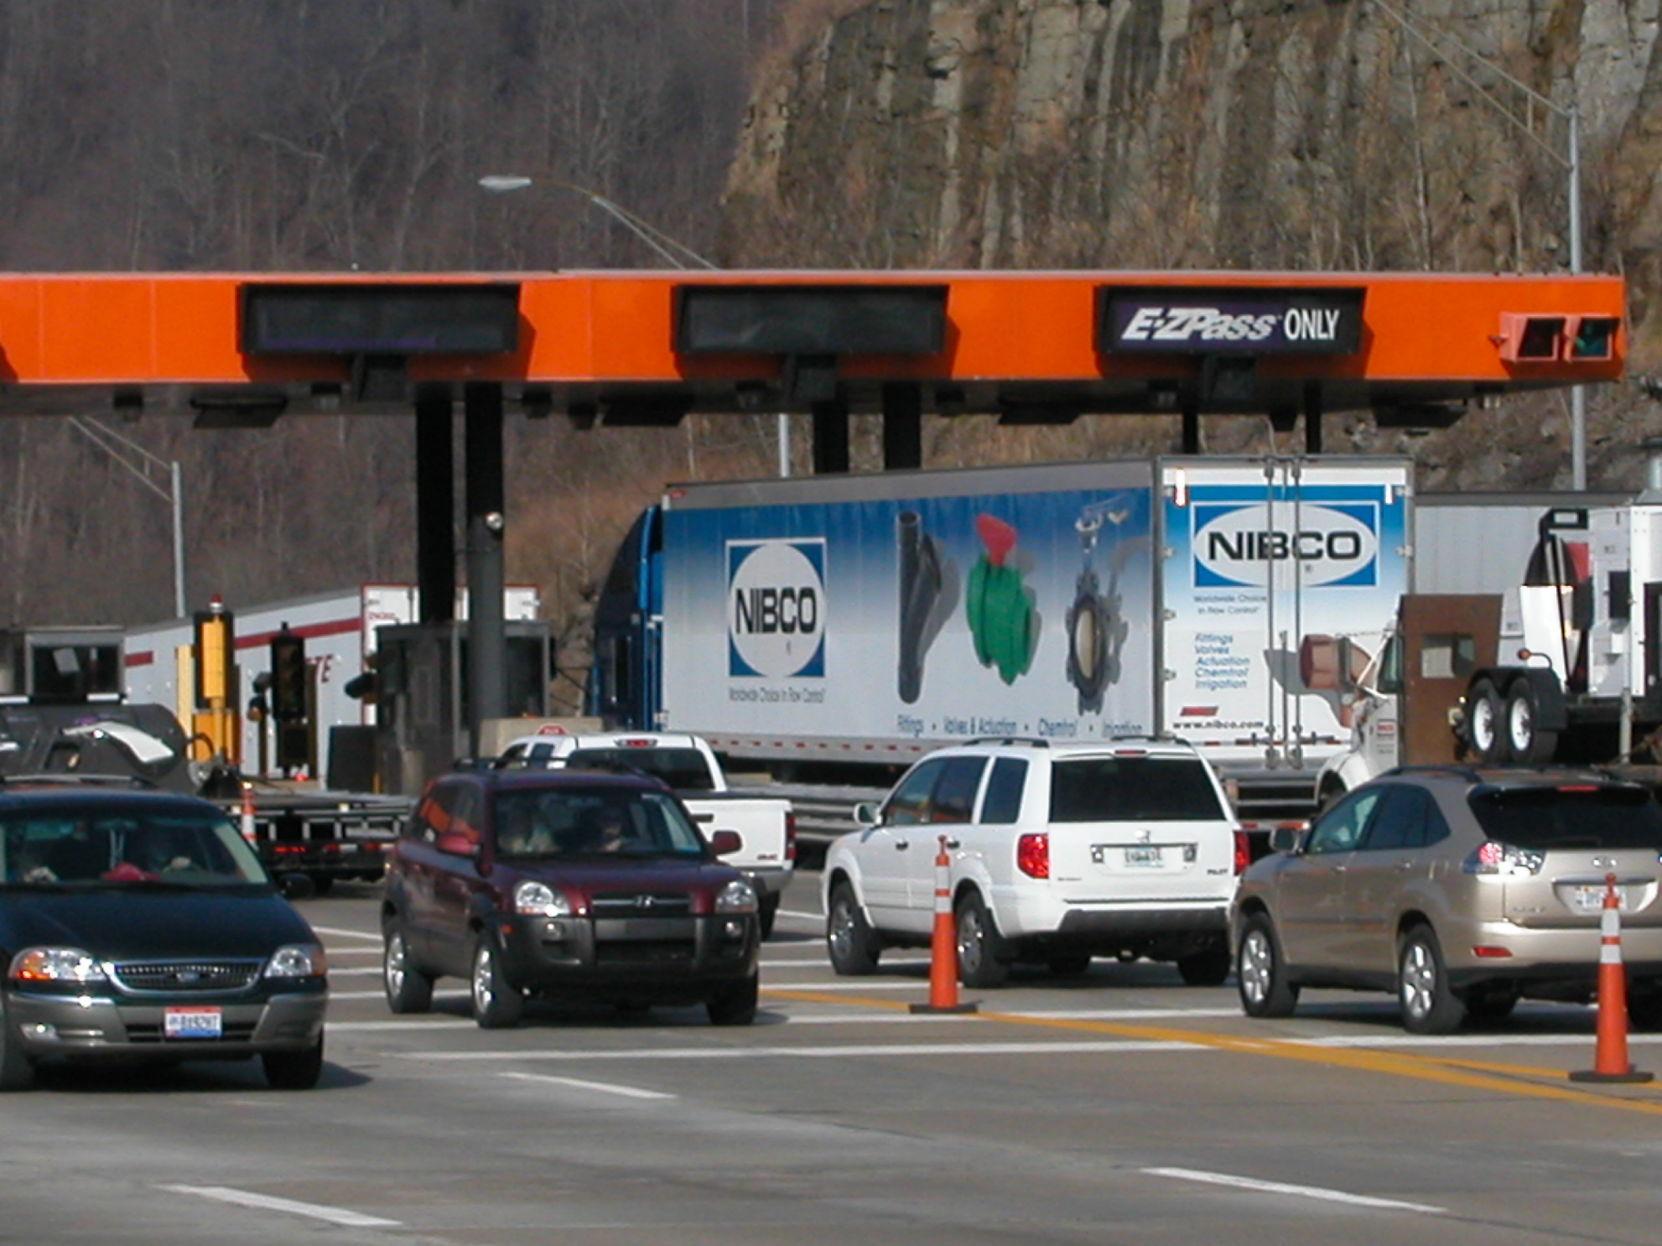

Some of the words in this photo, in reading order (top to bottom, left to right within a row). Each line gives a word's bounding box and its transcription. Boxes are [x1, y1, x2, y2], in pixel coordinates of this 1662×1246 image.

[1284, 308, 1340, 340] ONLY
[1208, 530, 1361, 561] NIBCO
[735, 586, 817, 634] NIBCO
[1195, 633, 1233, 645] Fittings
[1194, 645, 1229, 654] Valves
[1197, 656, 1250, 666] Actuation
[1195, 680, 1248, 691] Irrigation
[898, 714, 924, 737] Fittings
[944, 716, 968, 734] Valves
[978, 717, 1017, 735] Actuation
[1173, 720, 1264, 729] www.nibco.com
